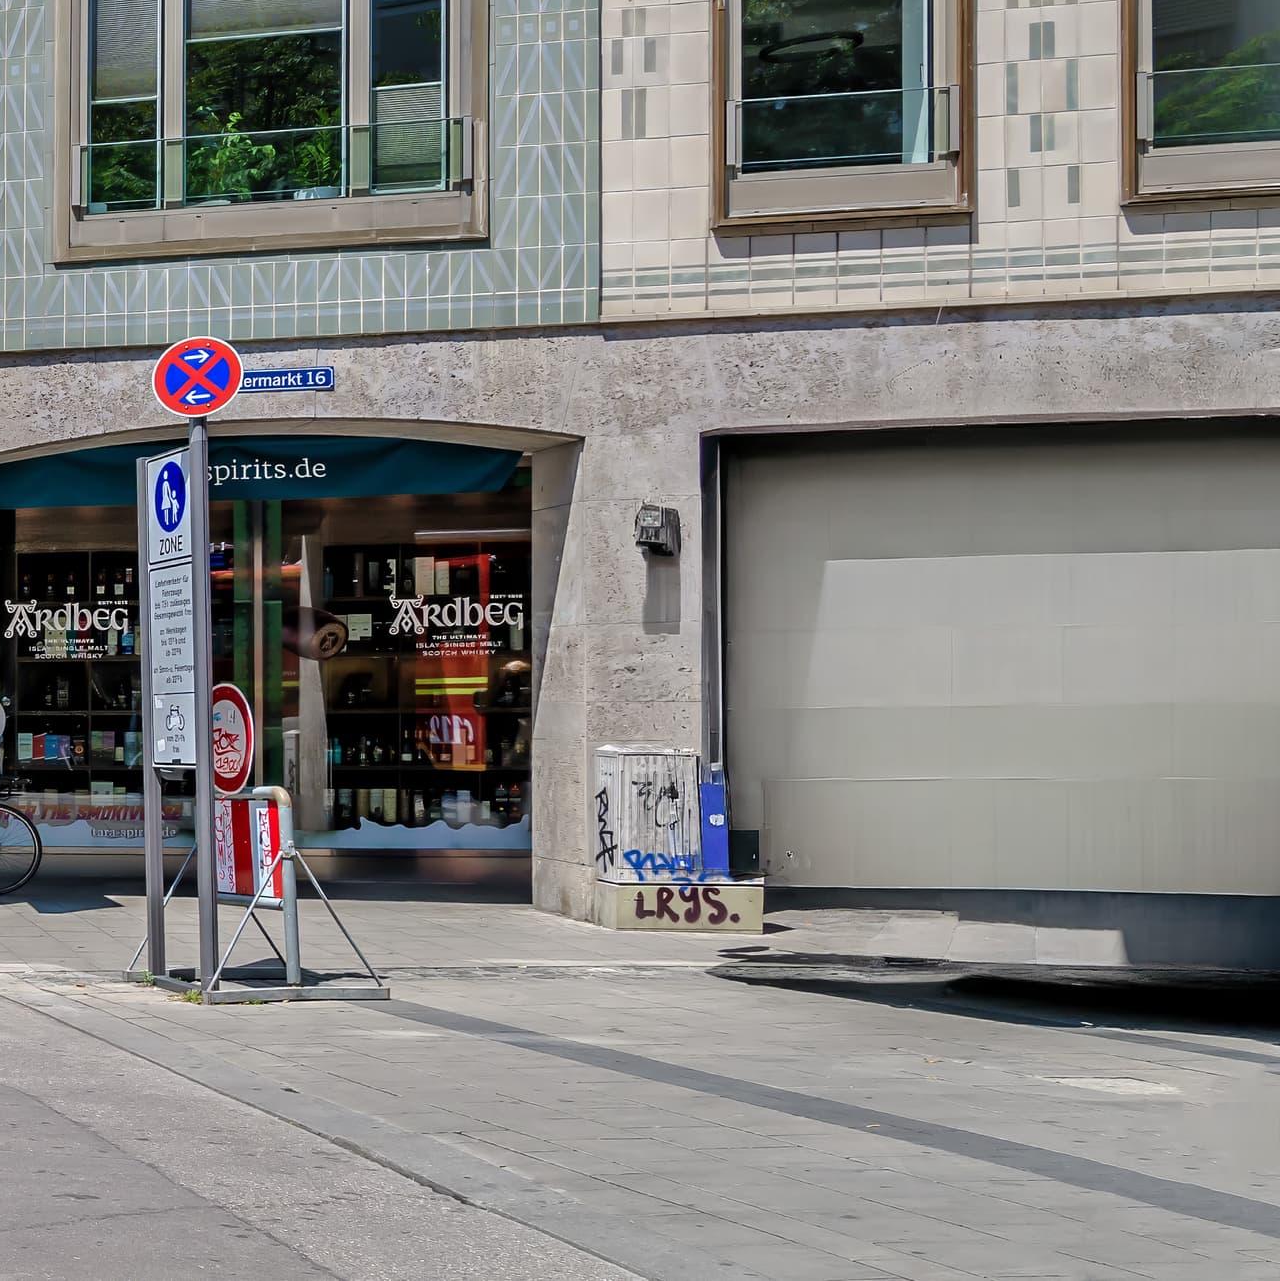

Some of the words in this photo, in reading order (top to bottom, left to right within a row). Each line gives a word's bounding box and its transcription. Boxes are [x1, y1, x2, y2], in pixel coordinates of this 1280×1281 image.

[240, 372, 303, 388] ermarkt
[306, 371, 326, 385] 16
[208, 458, 327, 486] spirits.de
[159, 534, 184, 556] ZONE
[4, 599, 128, 638] Ardbeg
[388, 594, 523, 635] Ardbeg
[479, 640, 503, 648] MALT
